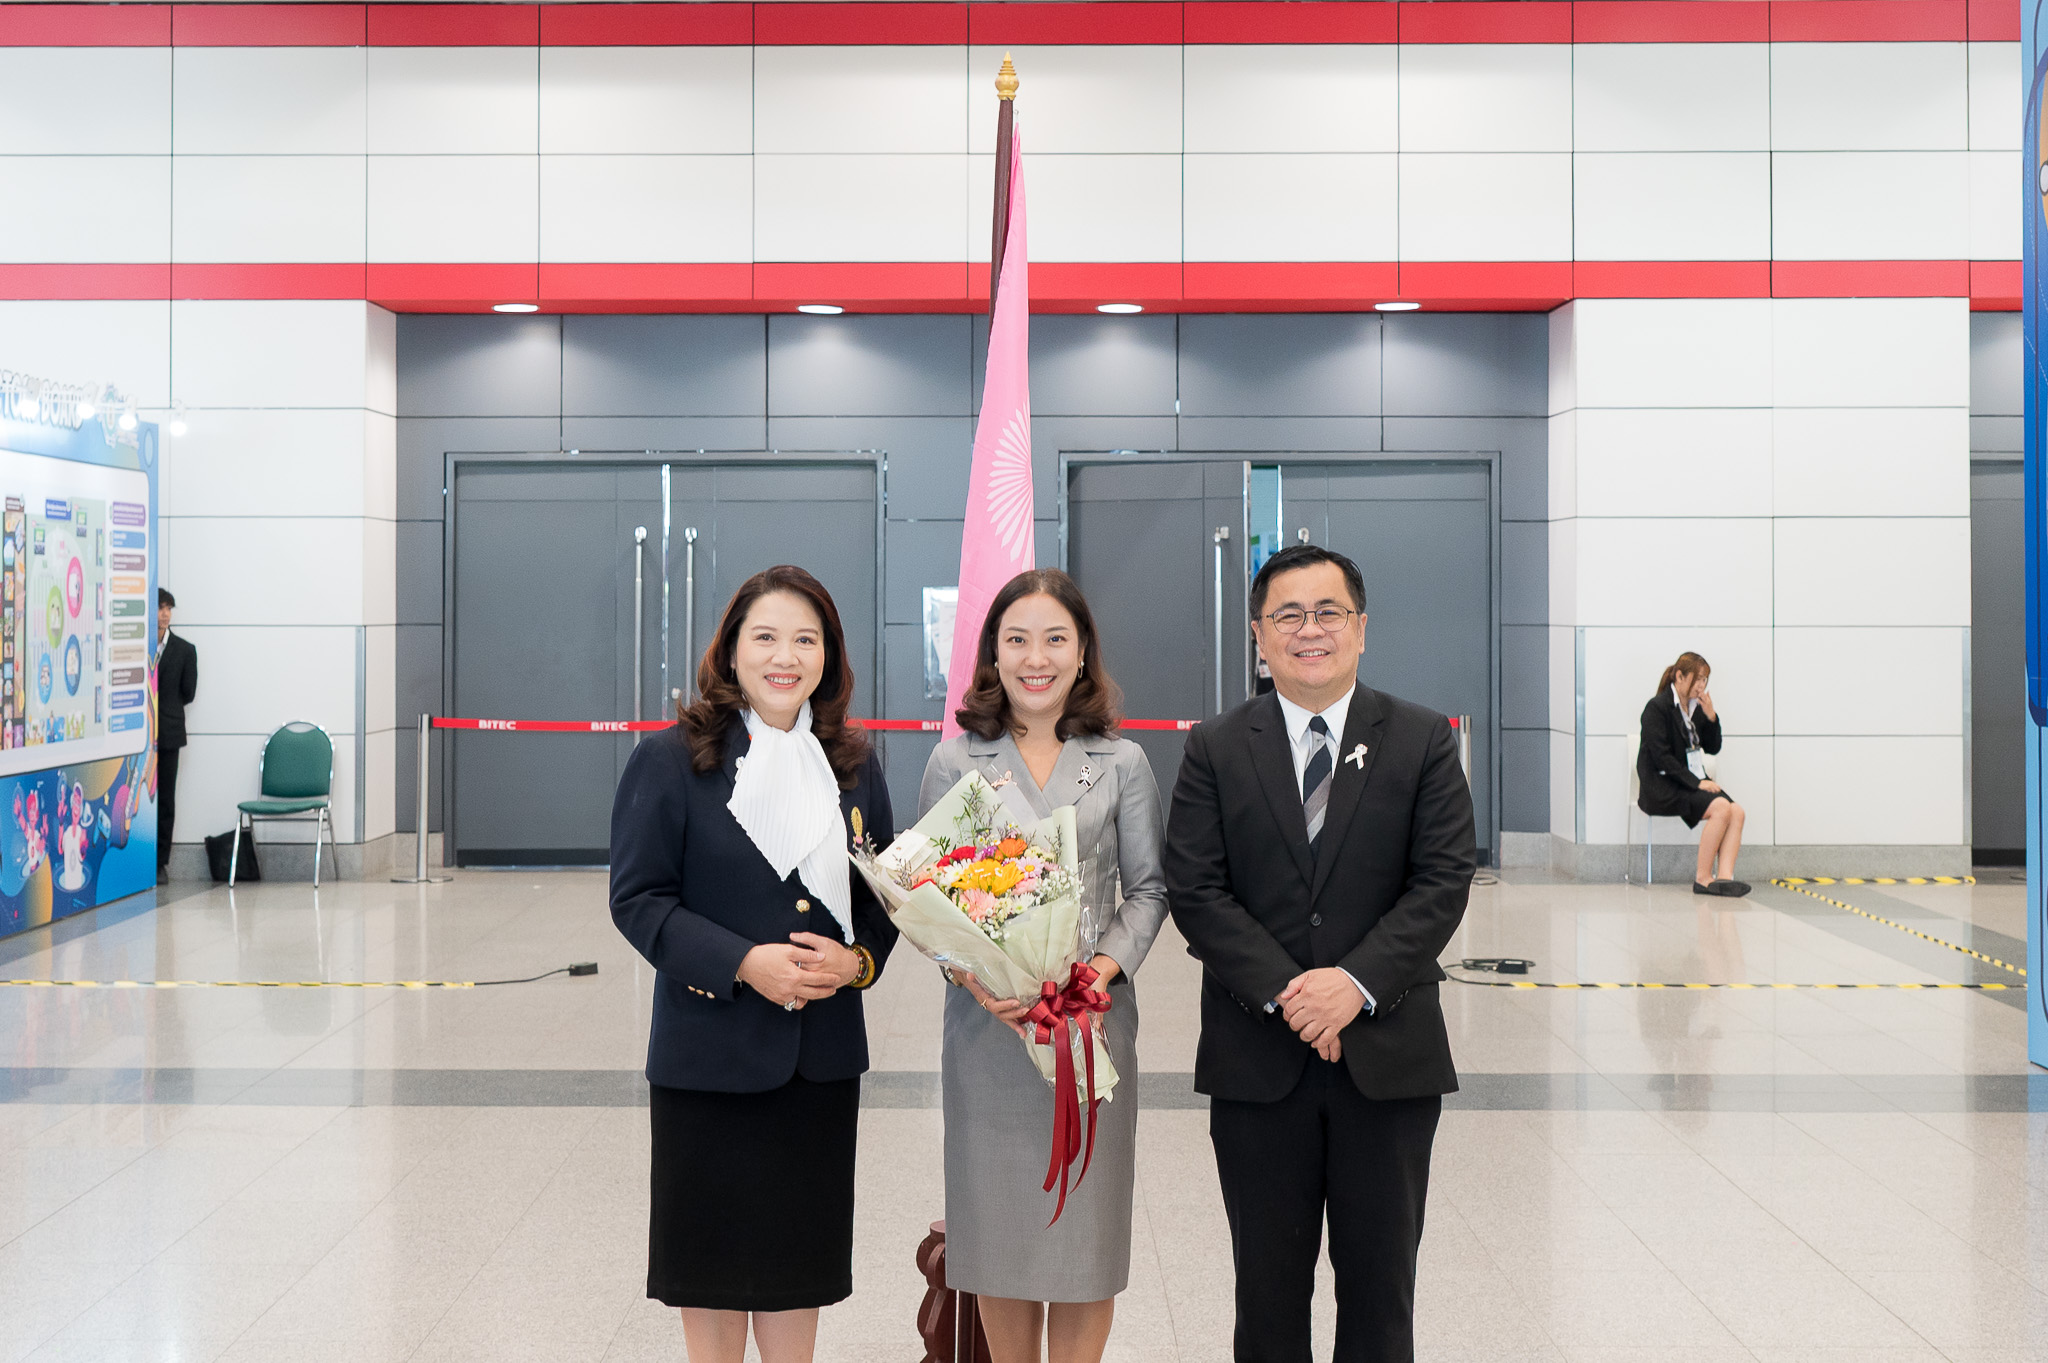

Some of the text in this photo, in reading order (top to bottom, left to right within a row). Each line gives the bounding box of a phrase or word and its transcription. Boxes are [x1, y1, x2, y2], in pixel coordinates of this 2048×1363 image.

[479, 719, 943, 731] BITEC BITEC BIT
